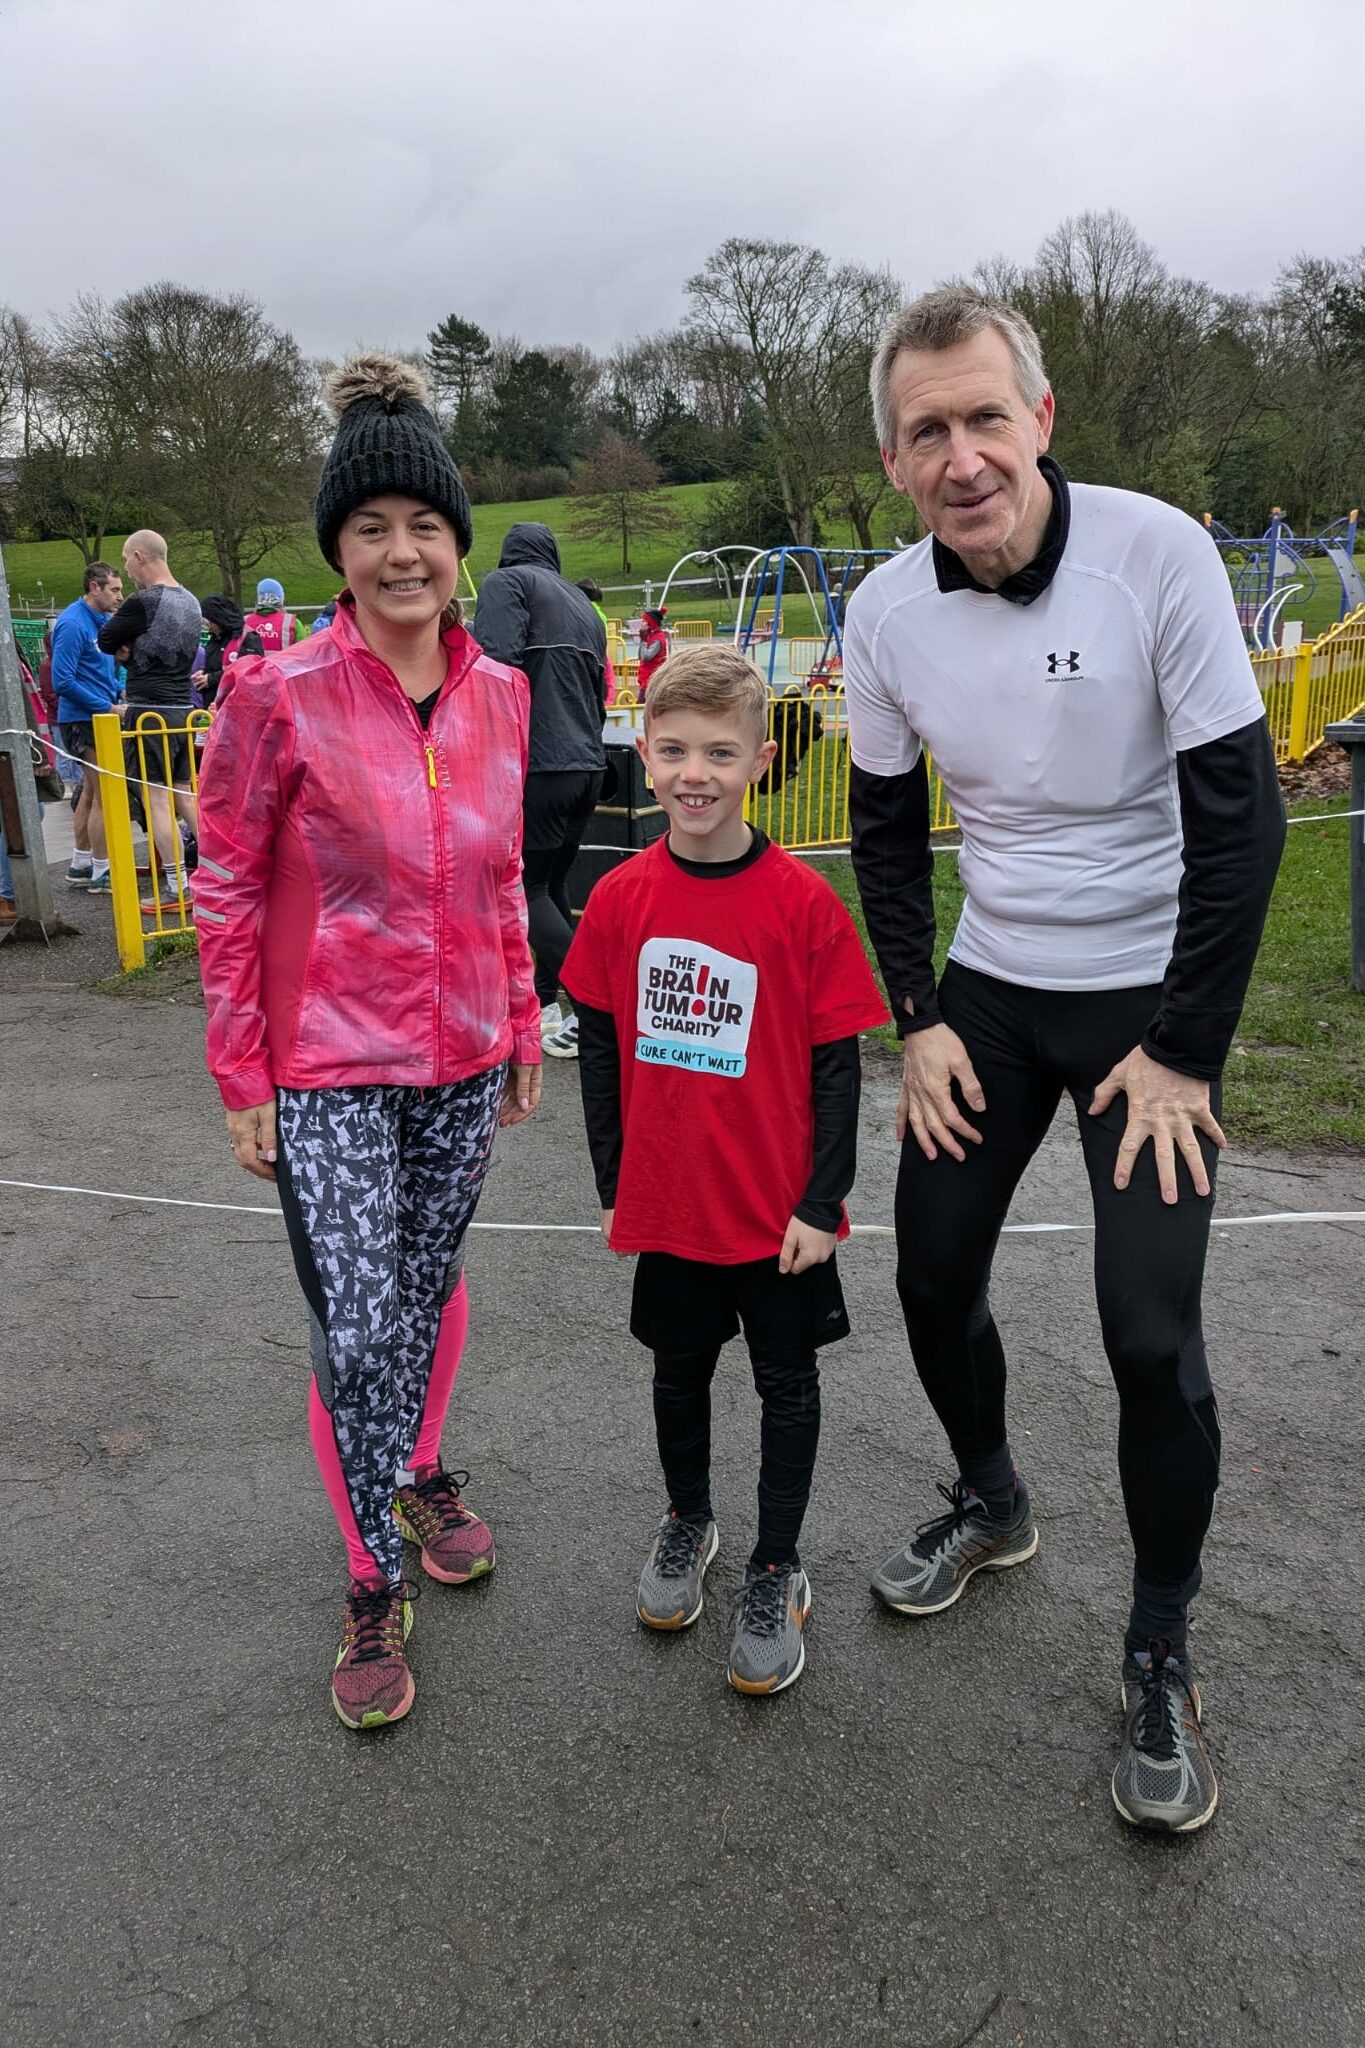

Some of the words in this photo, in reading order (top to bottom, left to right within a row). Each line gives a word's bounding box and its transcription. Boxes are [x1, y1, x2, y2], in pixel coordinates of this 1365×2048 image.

[668, 954, 697, 972] THE
[649, 965, 730, 1000] BRAIN
[644, 988, 743, 1026] TUMOUR
[651, 1015, 721, 1038] CHARITY
[640, 1044, 668, 1059] CURE
[671, 1049, 706, 1067] CAN'T
[708, 1055, 742, 1073] WAIT
